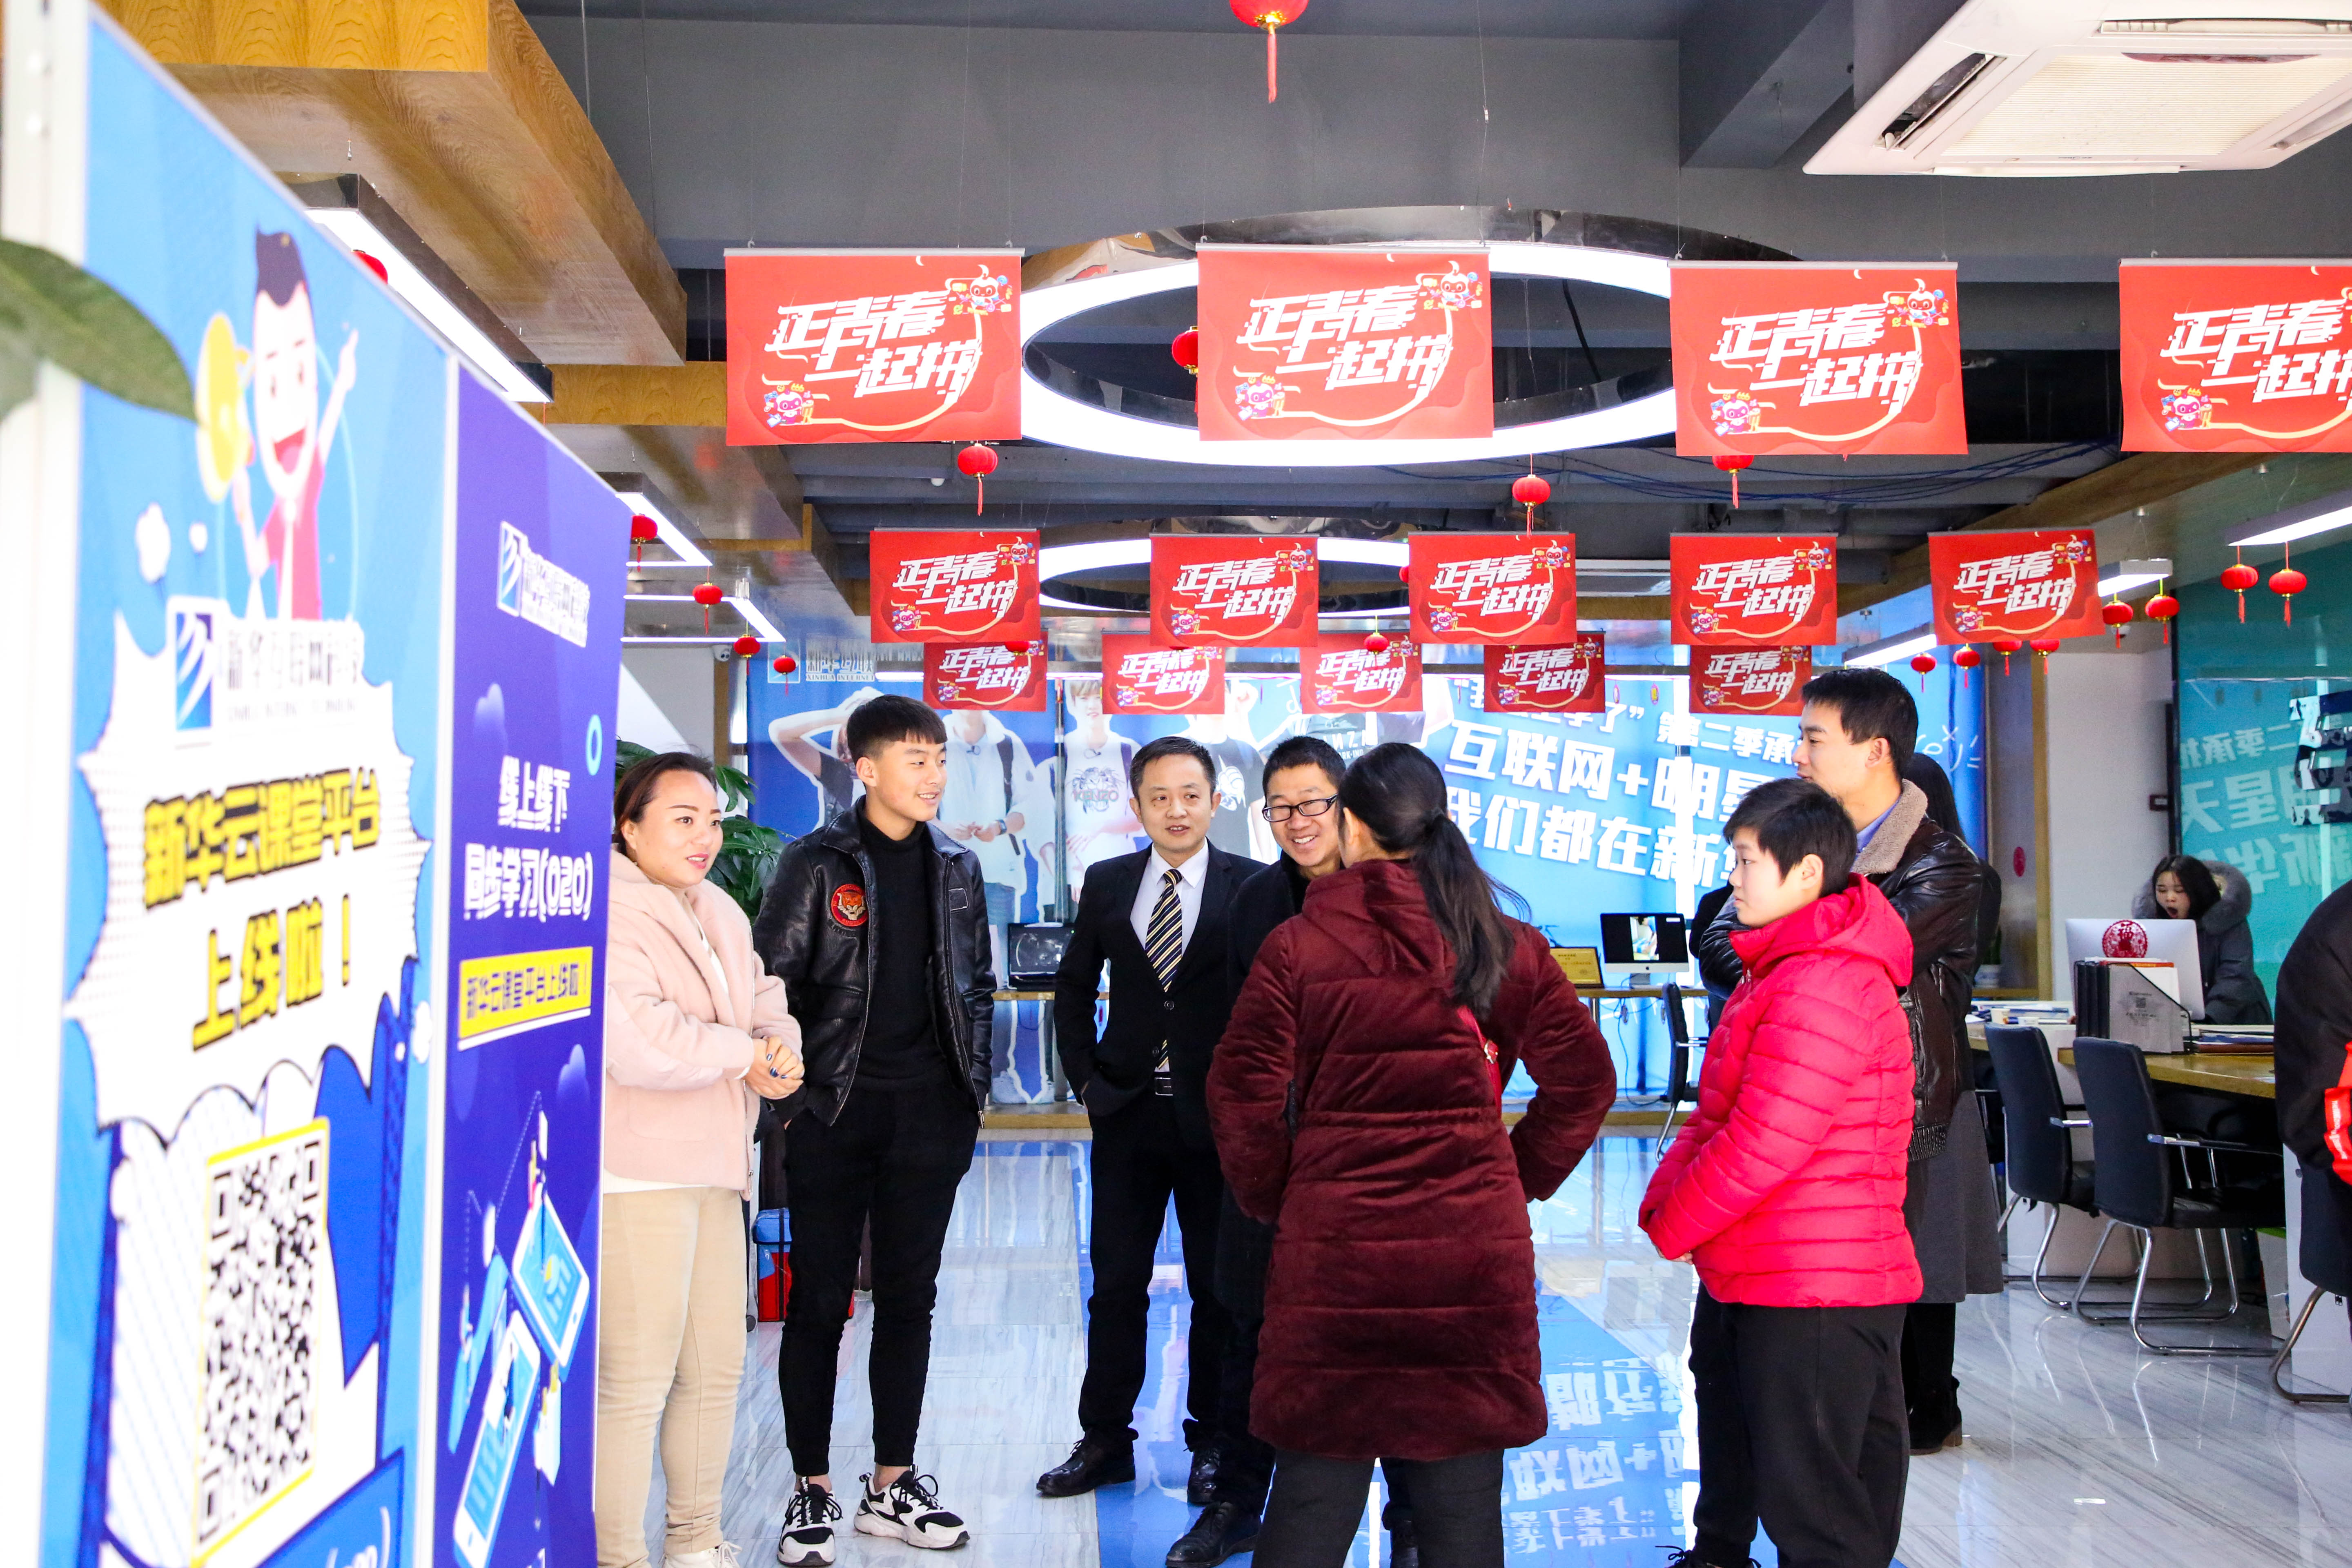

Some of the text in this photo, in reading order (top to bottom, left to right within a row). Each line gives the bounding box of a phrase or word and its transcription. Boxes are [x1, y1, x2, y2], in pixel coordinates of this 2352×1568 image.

[764, 290, 951, 370] 正青春
[1236, 284, 1421, 363] 正青春
[1710, 302, 1890, 379] 正青春
[2160, 298, 2347, 376] 正青春
[804, 339, 982, 404] 一起拼
[1276, 333, 1453, 400] 一起拼
[1750, 350, 1922, 414] 一起拼
[892, 551, 1000, 598] 正青春
[1172, 557, 1279, 603] 正青春
[1430, 555, 1535, 600] 正青春
[1692, 555, 1797, 601] 正青春
[1953, 550, 2055, 599] 正青春
[1977, 577, 2076, 616] 一起拼
[915, 579, 1018, 618] 一起拼
[1195, 585, 1297, 624] 一起拼
[1452, 582, 1553, 620] 一起拼
[1714, 584, 1815, 622] 一起拼
[955, 666, 1031, 695] 一起拼
[1134, 669, 1209, 699] 一起拼
[1332, 667, 1406, 695] 一起拼
[1499, 648, 1575, 681] 正青春
[1515, 668, 1589, 696] 一起拼
[1705, 650, 1782, 683] 正青春
[1720, 671, 1795, 699] 一起拼
[498, 755, 570, 833] 线上线下
[1073, 790, 1119, 802] KENZO
[143, 766, 380, 910] 新华云课堂平台
[1446, 786, 1736, 888] 我们都在新
